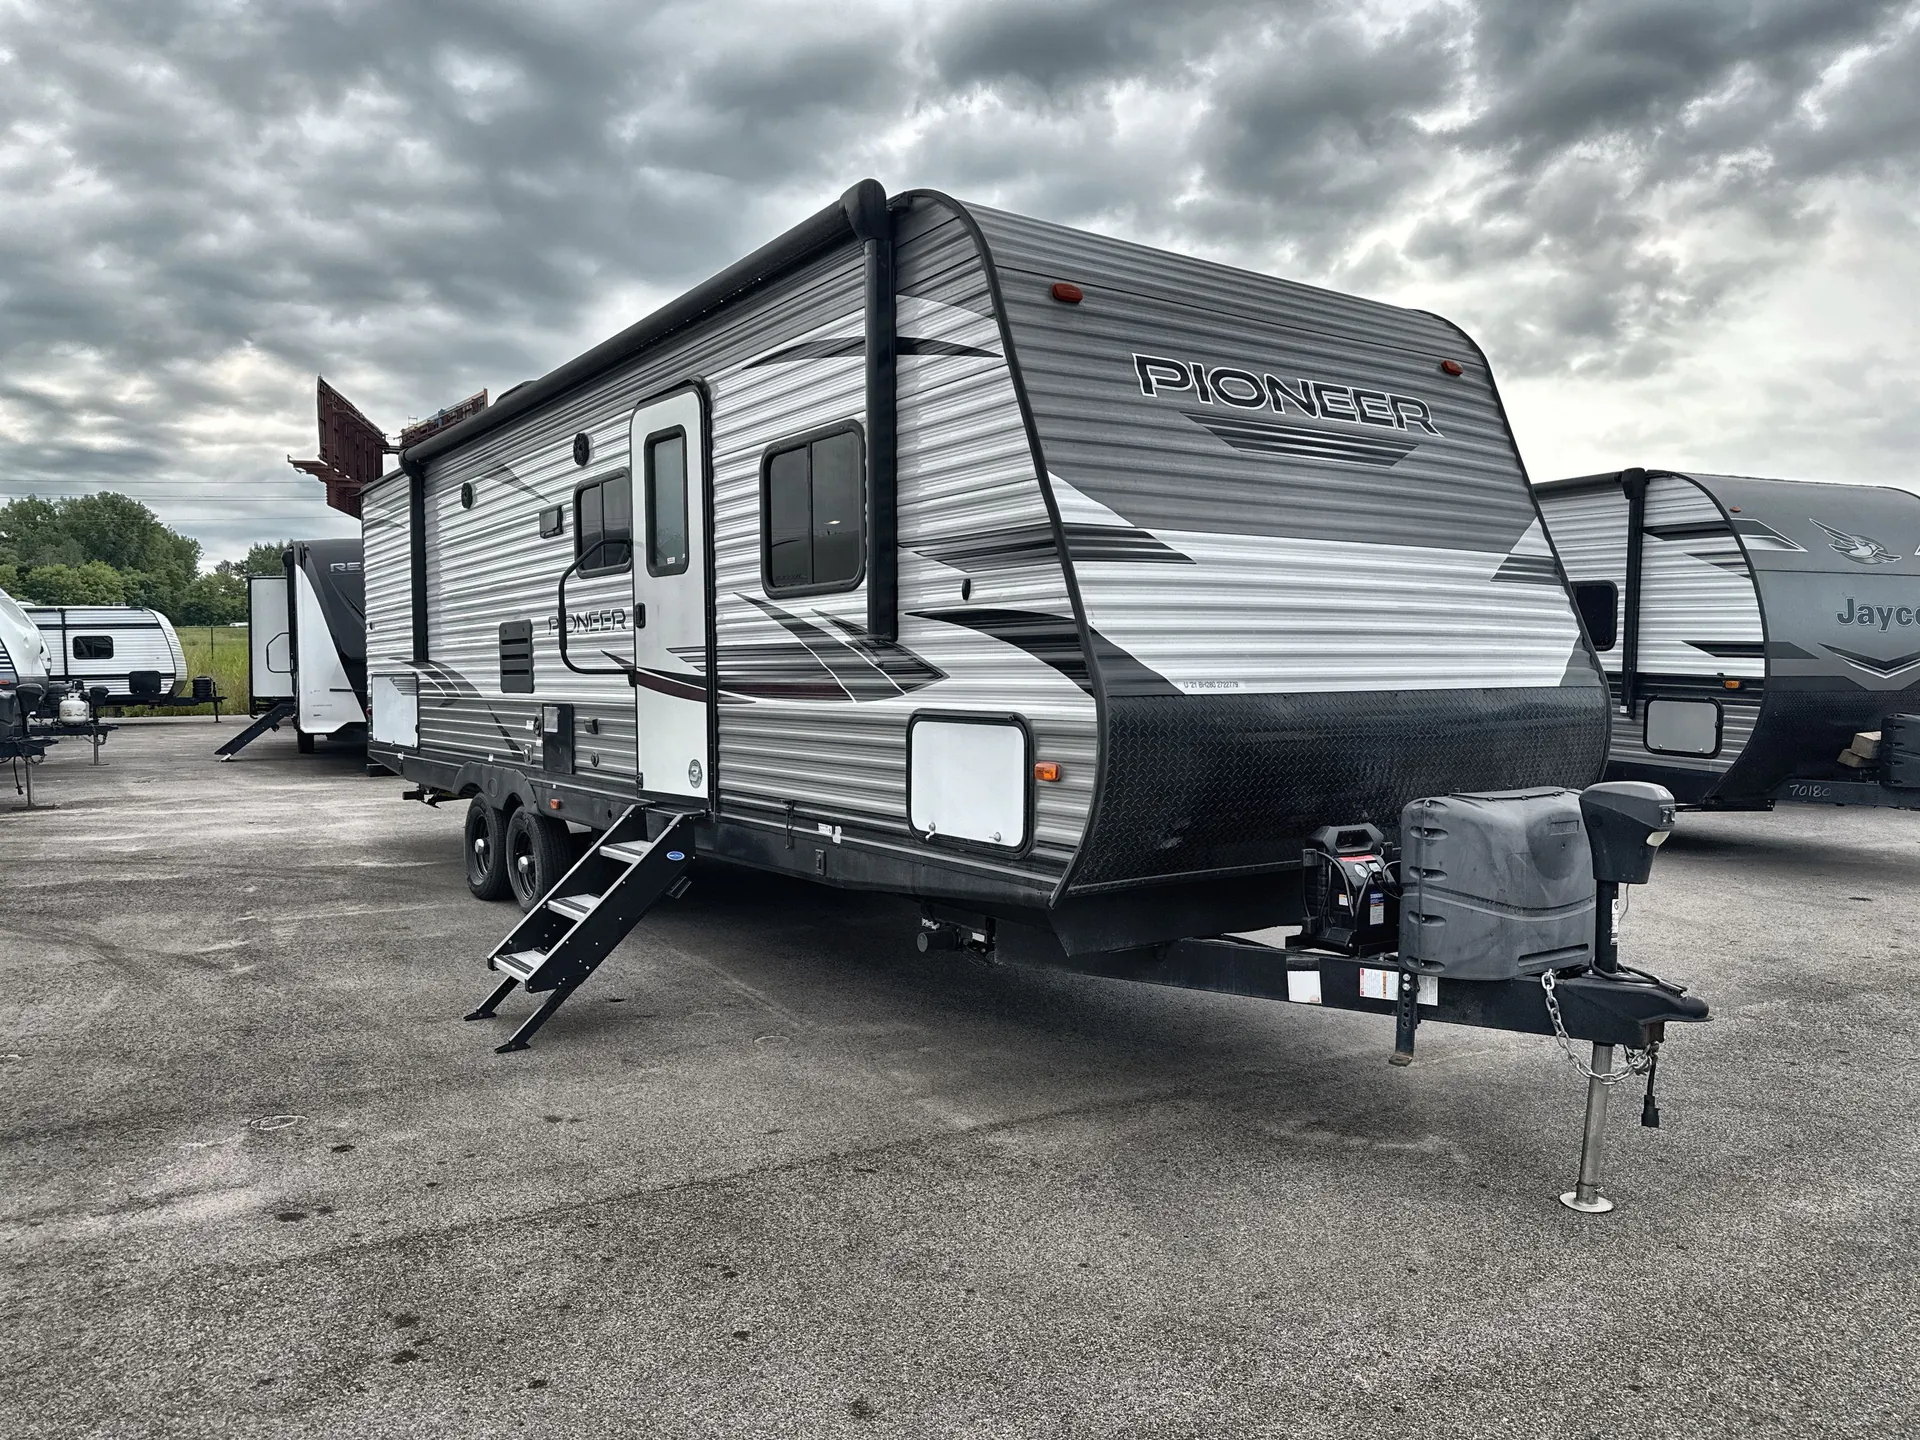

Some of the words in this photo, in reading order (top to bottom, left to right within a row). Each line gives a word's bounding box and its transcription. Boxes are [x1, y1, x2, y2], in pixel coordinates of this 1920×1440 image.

[1131, 353, 1444, 438] PIONEER
[548, 608, 627, 635] PONEER
[1789, 784, 1831, 798] 70180
